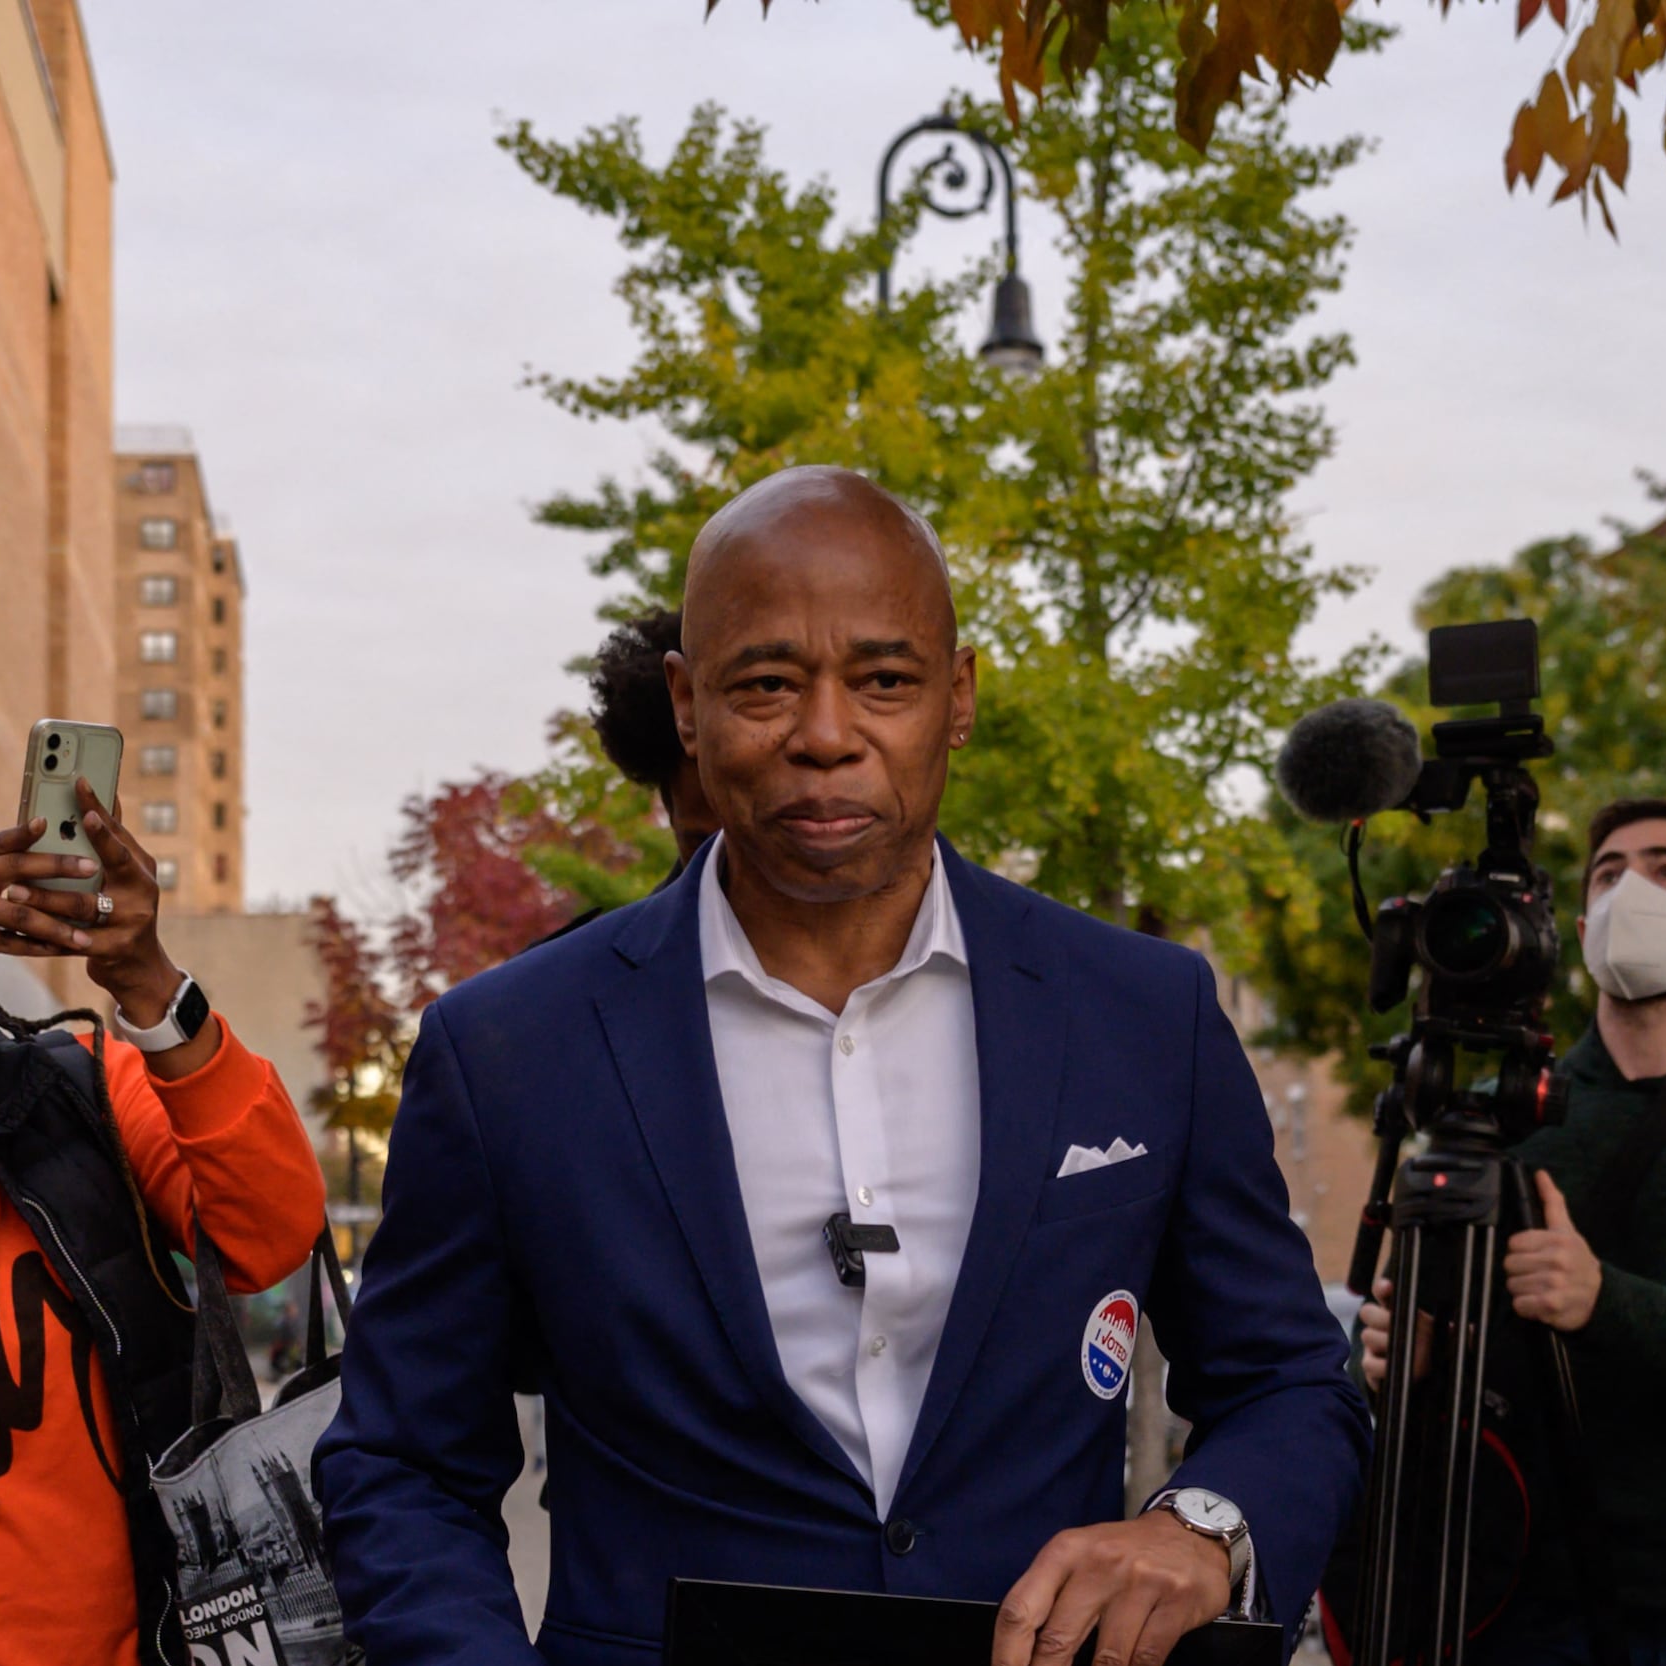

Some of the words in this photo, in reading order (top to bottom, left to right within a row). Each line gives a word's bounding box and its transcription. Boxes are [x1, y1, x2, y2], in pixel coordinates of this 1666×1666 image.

[1095, 1328, 1101, 1341] I
[179, 1584, 258, 1626] LONDON
[221, 1602, 266, 1629] ONDON
